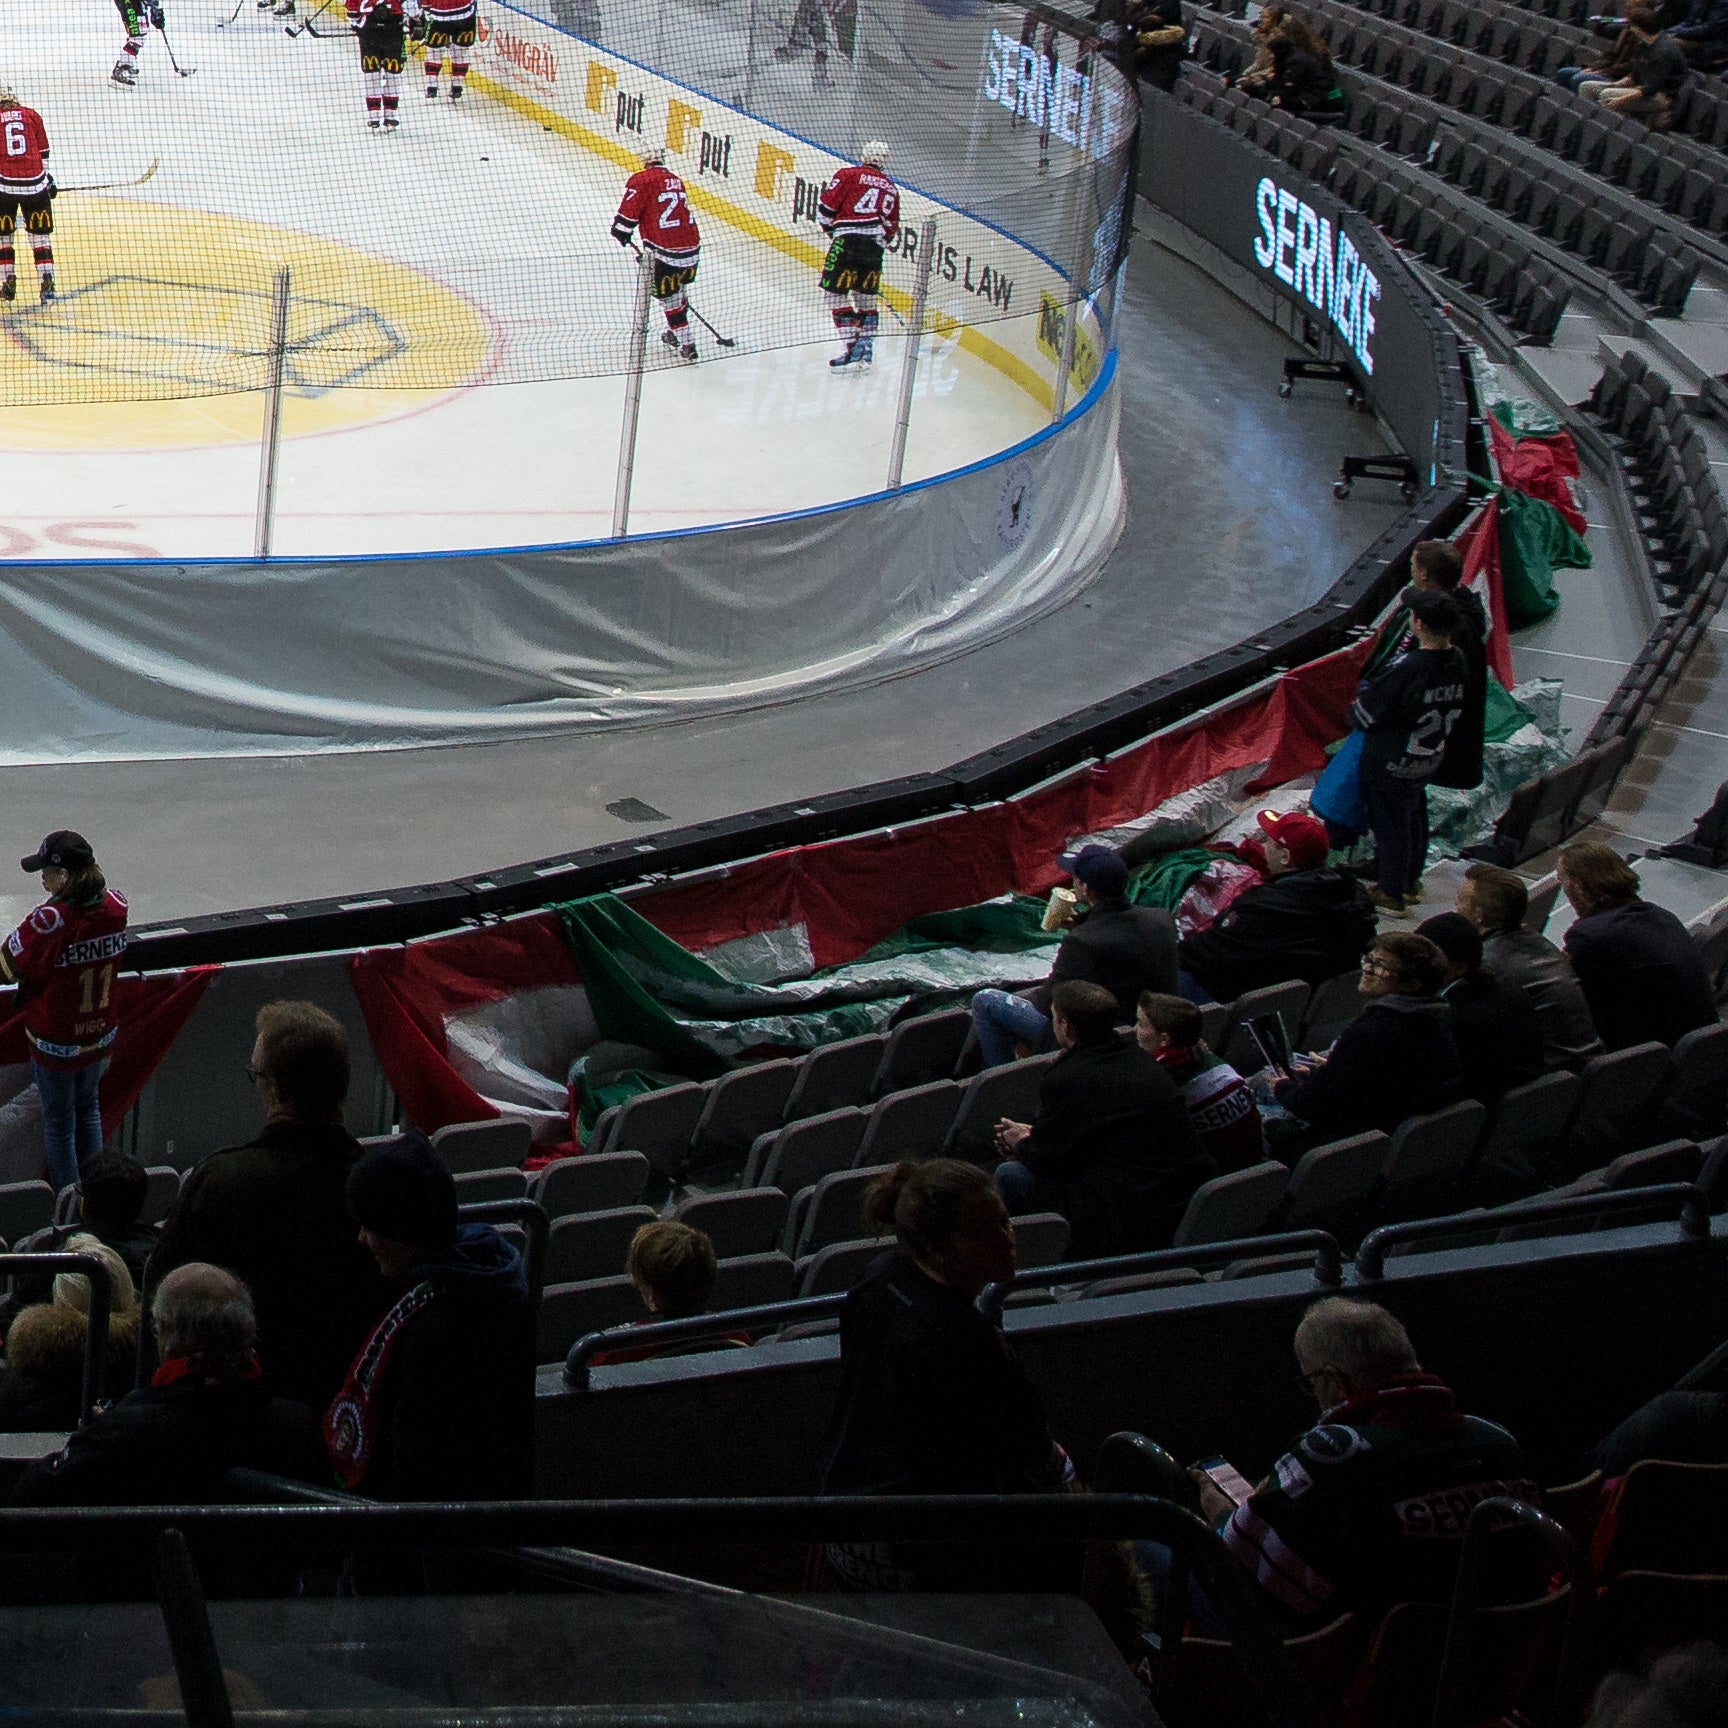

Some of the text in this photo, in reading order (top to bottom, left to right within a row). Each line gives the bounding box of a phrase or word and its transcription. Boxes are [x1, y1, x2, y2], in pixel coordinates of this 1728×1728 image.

[615, 90, 645, 135] put
[4, 121, 28, 157] 6
[698, 130, 732, 179] put
[964, 255, 1014, 312] LAW
[1253, 176, 1383, 377] SERNEKE
